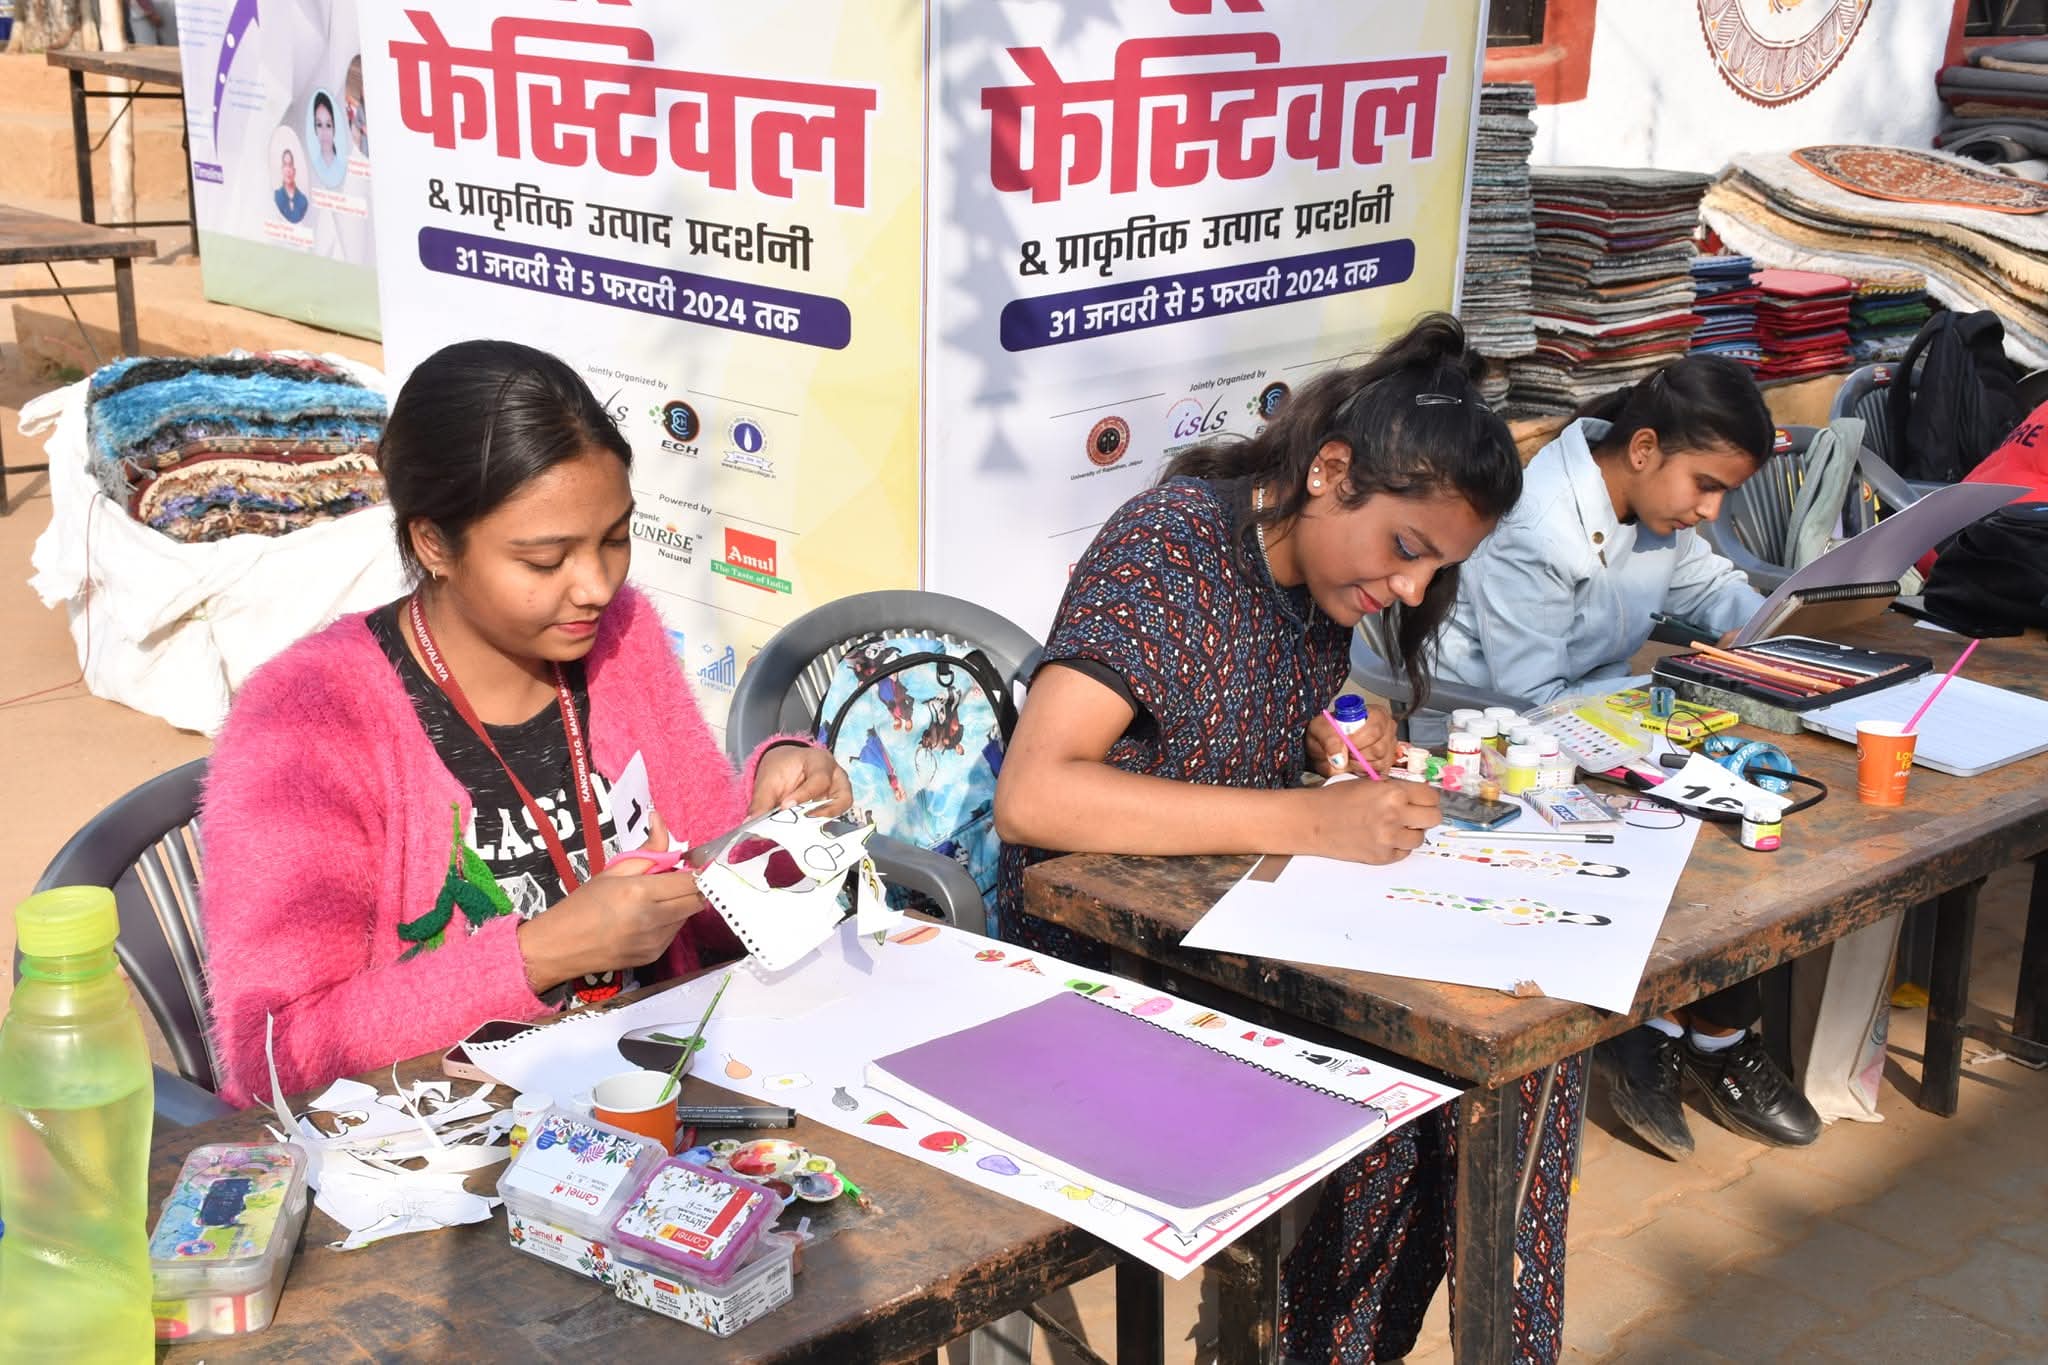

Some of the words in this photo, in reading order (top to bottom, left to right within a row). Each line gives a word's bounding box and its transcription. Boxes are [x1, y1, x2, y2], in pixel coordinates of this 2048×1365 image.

[388, 9, 877, 209] फेस्टिवल
[981, 31, 1447, 204] फेस्टिवल
[428, 178, 451, 213] &
[455, 181, 574, 231] प्राकृतिक
[585, 203, 673, 248] उत्पाद
[686, 222, 814, 272] प्रदर्शनी
[1018, 240, 1049, 277] &
[1056, 213, 1191, 278] प्राकृतिक
[1202, 207, 1284, 251] उत्पाद
[1295, 184, 1394, 239] प्रदर्शनी
[455, 246, 478, 273] 31
[482, 255, 550, 288] जनवरी
[553, 261, 575, 293] से
[581, 270, 596, 296] 5
[600, 274, 677, 312] फरवरी
[681, 289, 748, 326] 2024
[753, 300, 801, 334] तक
[1048, 308, 1076, 339] 31
[1083, 285, 1159, 331] जनवरी
[1163, 281, 1184, 317] से
[1190, 286, 1205, 314] 5
[1210, 266, 1281, 309] फरवरी
[1286, 265, 1339, 298] 2024
[1344, 257, 1380, 288] तक
[587, 365, 614, 379] Jointly
[614, 370, 656, 388] Organized
[657, 380, 669, 391] by
[1189, 377, 1216, 394] Jointly
[1216, 371, 1256, 390] Organized
[1256, 369, 1267, 381] by
[660, 439, 699, 456] ECH
[632, 509, 661, 523] rganic
[658, 493, 699, 511] Powered
[700, 504, 713, 516] by
[631, 521, 694, 552] UNRISE
[657, 548, 692, 565] Natural
[727, 545, 775, 573] Amul
[713, 562, 731, 576] The
[731, 567, 754, 582] Taste
[755, 574, 765, 585] of
[766, 577, 790, 592] India
[577, 757, 592, 803] KANORIA
[565, 1186, 600, 1207] Camel
[528, 1225, 553, 1241] Camel
[672, 1230, 710, 1249] Camel
